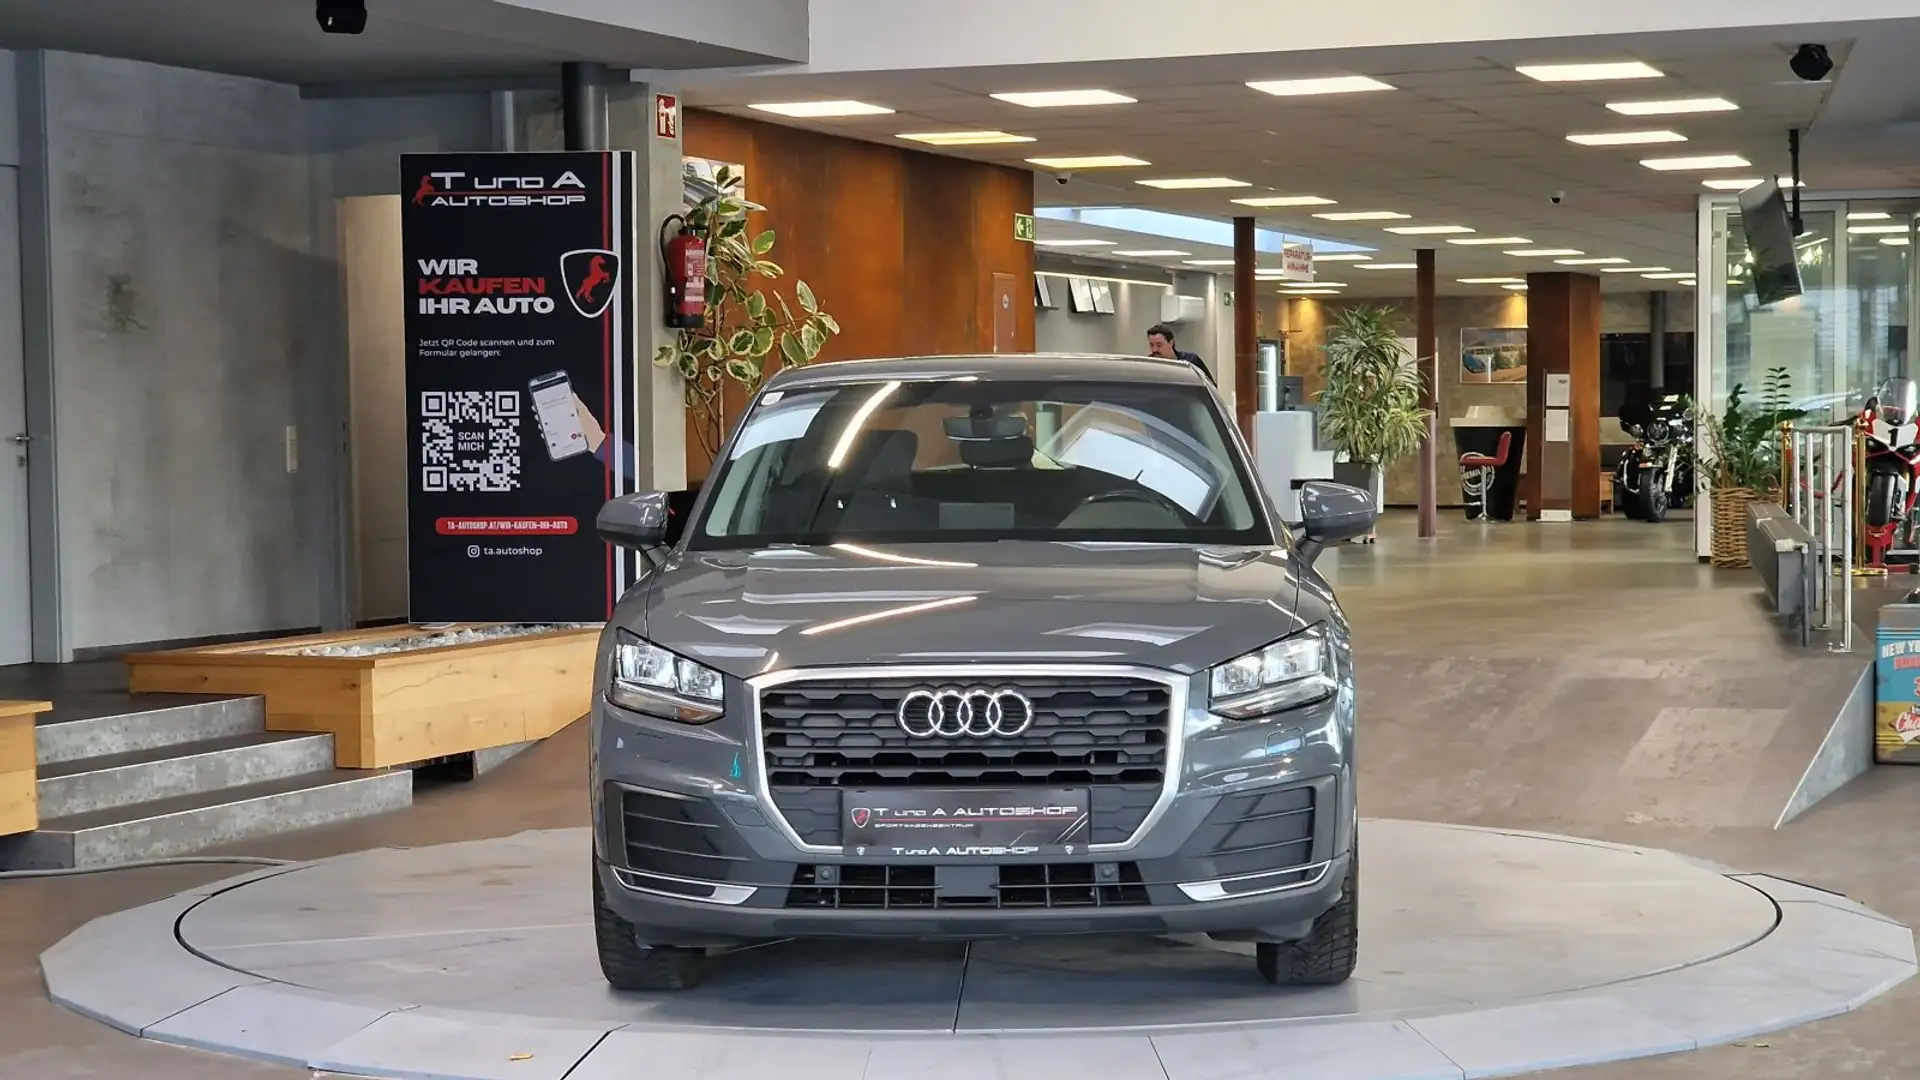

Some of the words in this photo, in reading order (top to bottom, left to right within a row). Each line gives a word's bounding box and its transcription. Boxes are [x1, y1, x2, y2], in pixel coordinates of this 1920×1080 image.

[430, 172, 465, 189] T
[551, 171, 586, 189] A
[431, 195, 586, 206] AUTOSHOP
[417, 259, 478, 275] WIR
[418, 277, 545, 295] KAUFEN
[419, 298, 471, 315] IHR
[474, 297, 555, 315] AUTO
[419, 338, 440, 347] Jetzt
[441, 339, 455, 348] QR
[456, 339, 478, 347] Code
[480, 339, 515, 347] scannen
[517, 338, 534, 346] und
[419, 349, 458, 357] Formular
[458, 431, 485, 441] SCAN
[1888, 428, 1899, 447] 1
[458, 441, 485, 451] MICH
[483, 546, 543, 556] ta.autoshop
[1881, 641, 1905, 659] NEW
[873, 807, 889, 816] T
[931, 807, 947, 816] A
[953, 806, 1078, 816] AUTOSHOP
[891, 847, 905, 855] T
[928, 846, 941, 855] A
[945, 846, 1039, 855] AUTOSHOP
